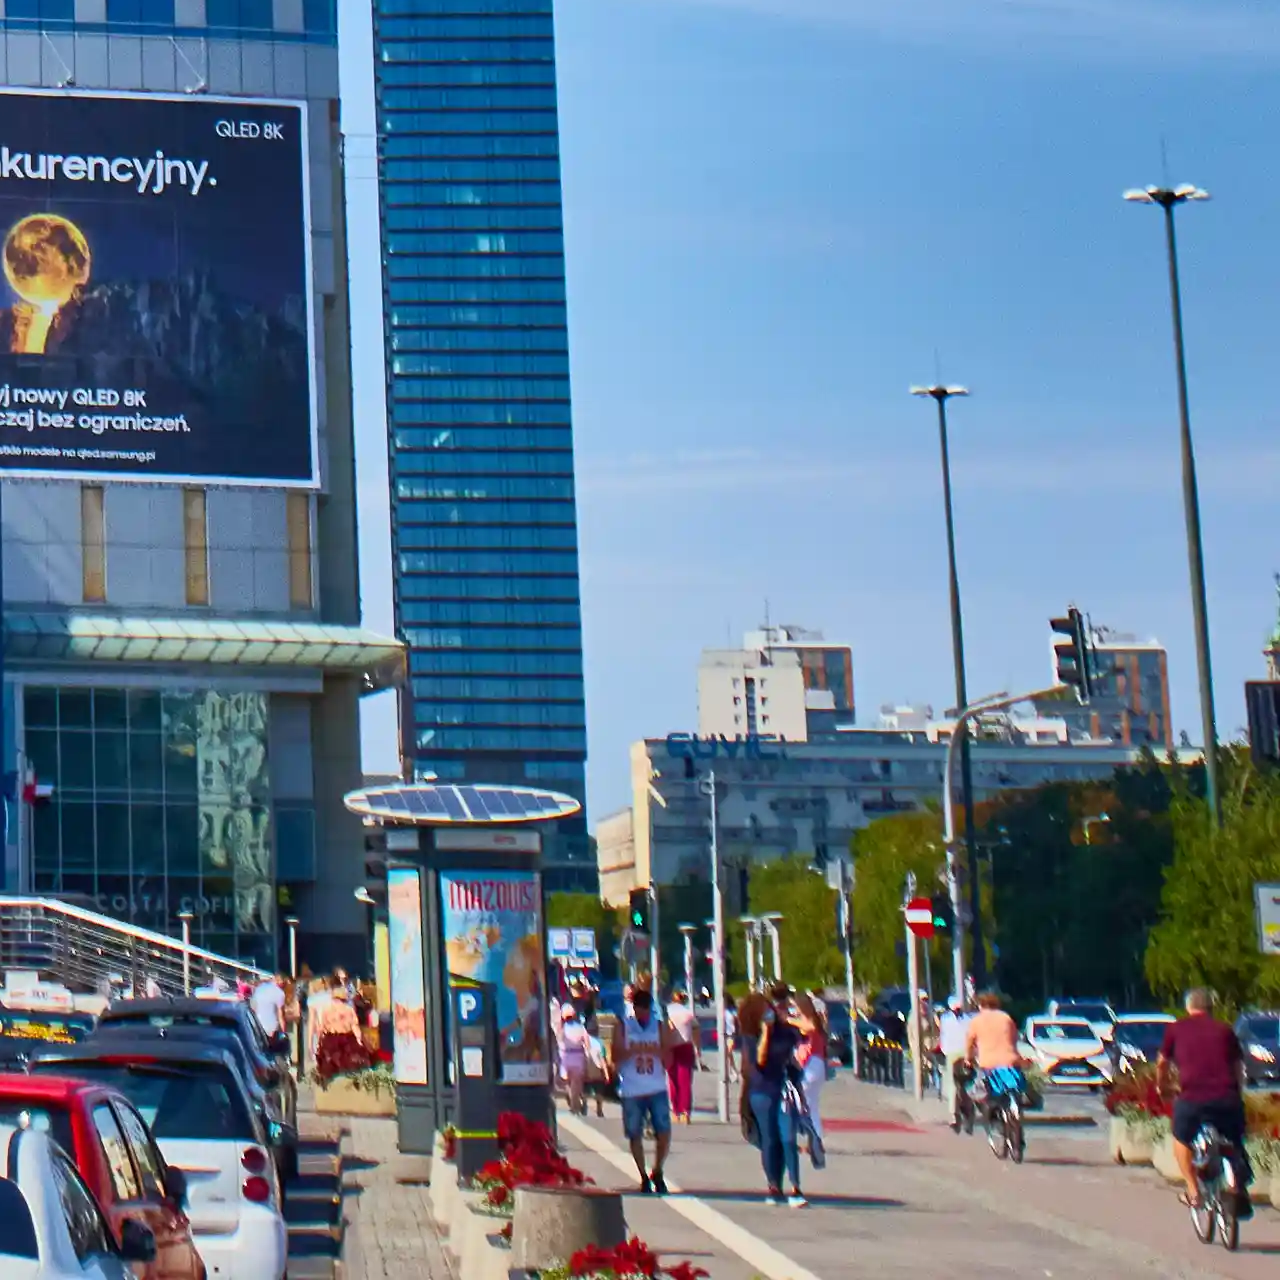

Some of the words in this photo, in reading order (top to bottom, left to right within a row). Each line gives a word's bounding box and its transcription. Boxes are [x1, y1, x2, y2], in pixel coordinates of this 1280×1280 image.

[215, 120, 260, 139] QLED
[263, 123, 285, 140] 8K
[12, 387, 69, 410] nowy
[72, 388, 120, 407] QLED
[123, 390, 148, 408] 8K
[37, 409, 75, 428] bez
[78, 412, 191, 435] ograniczeń.
